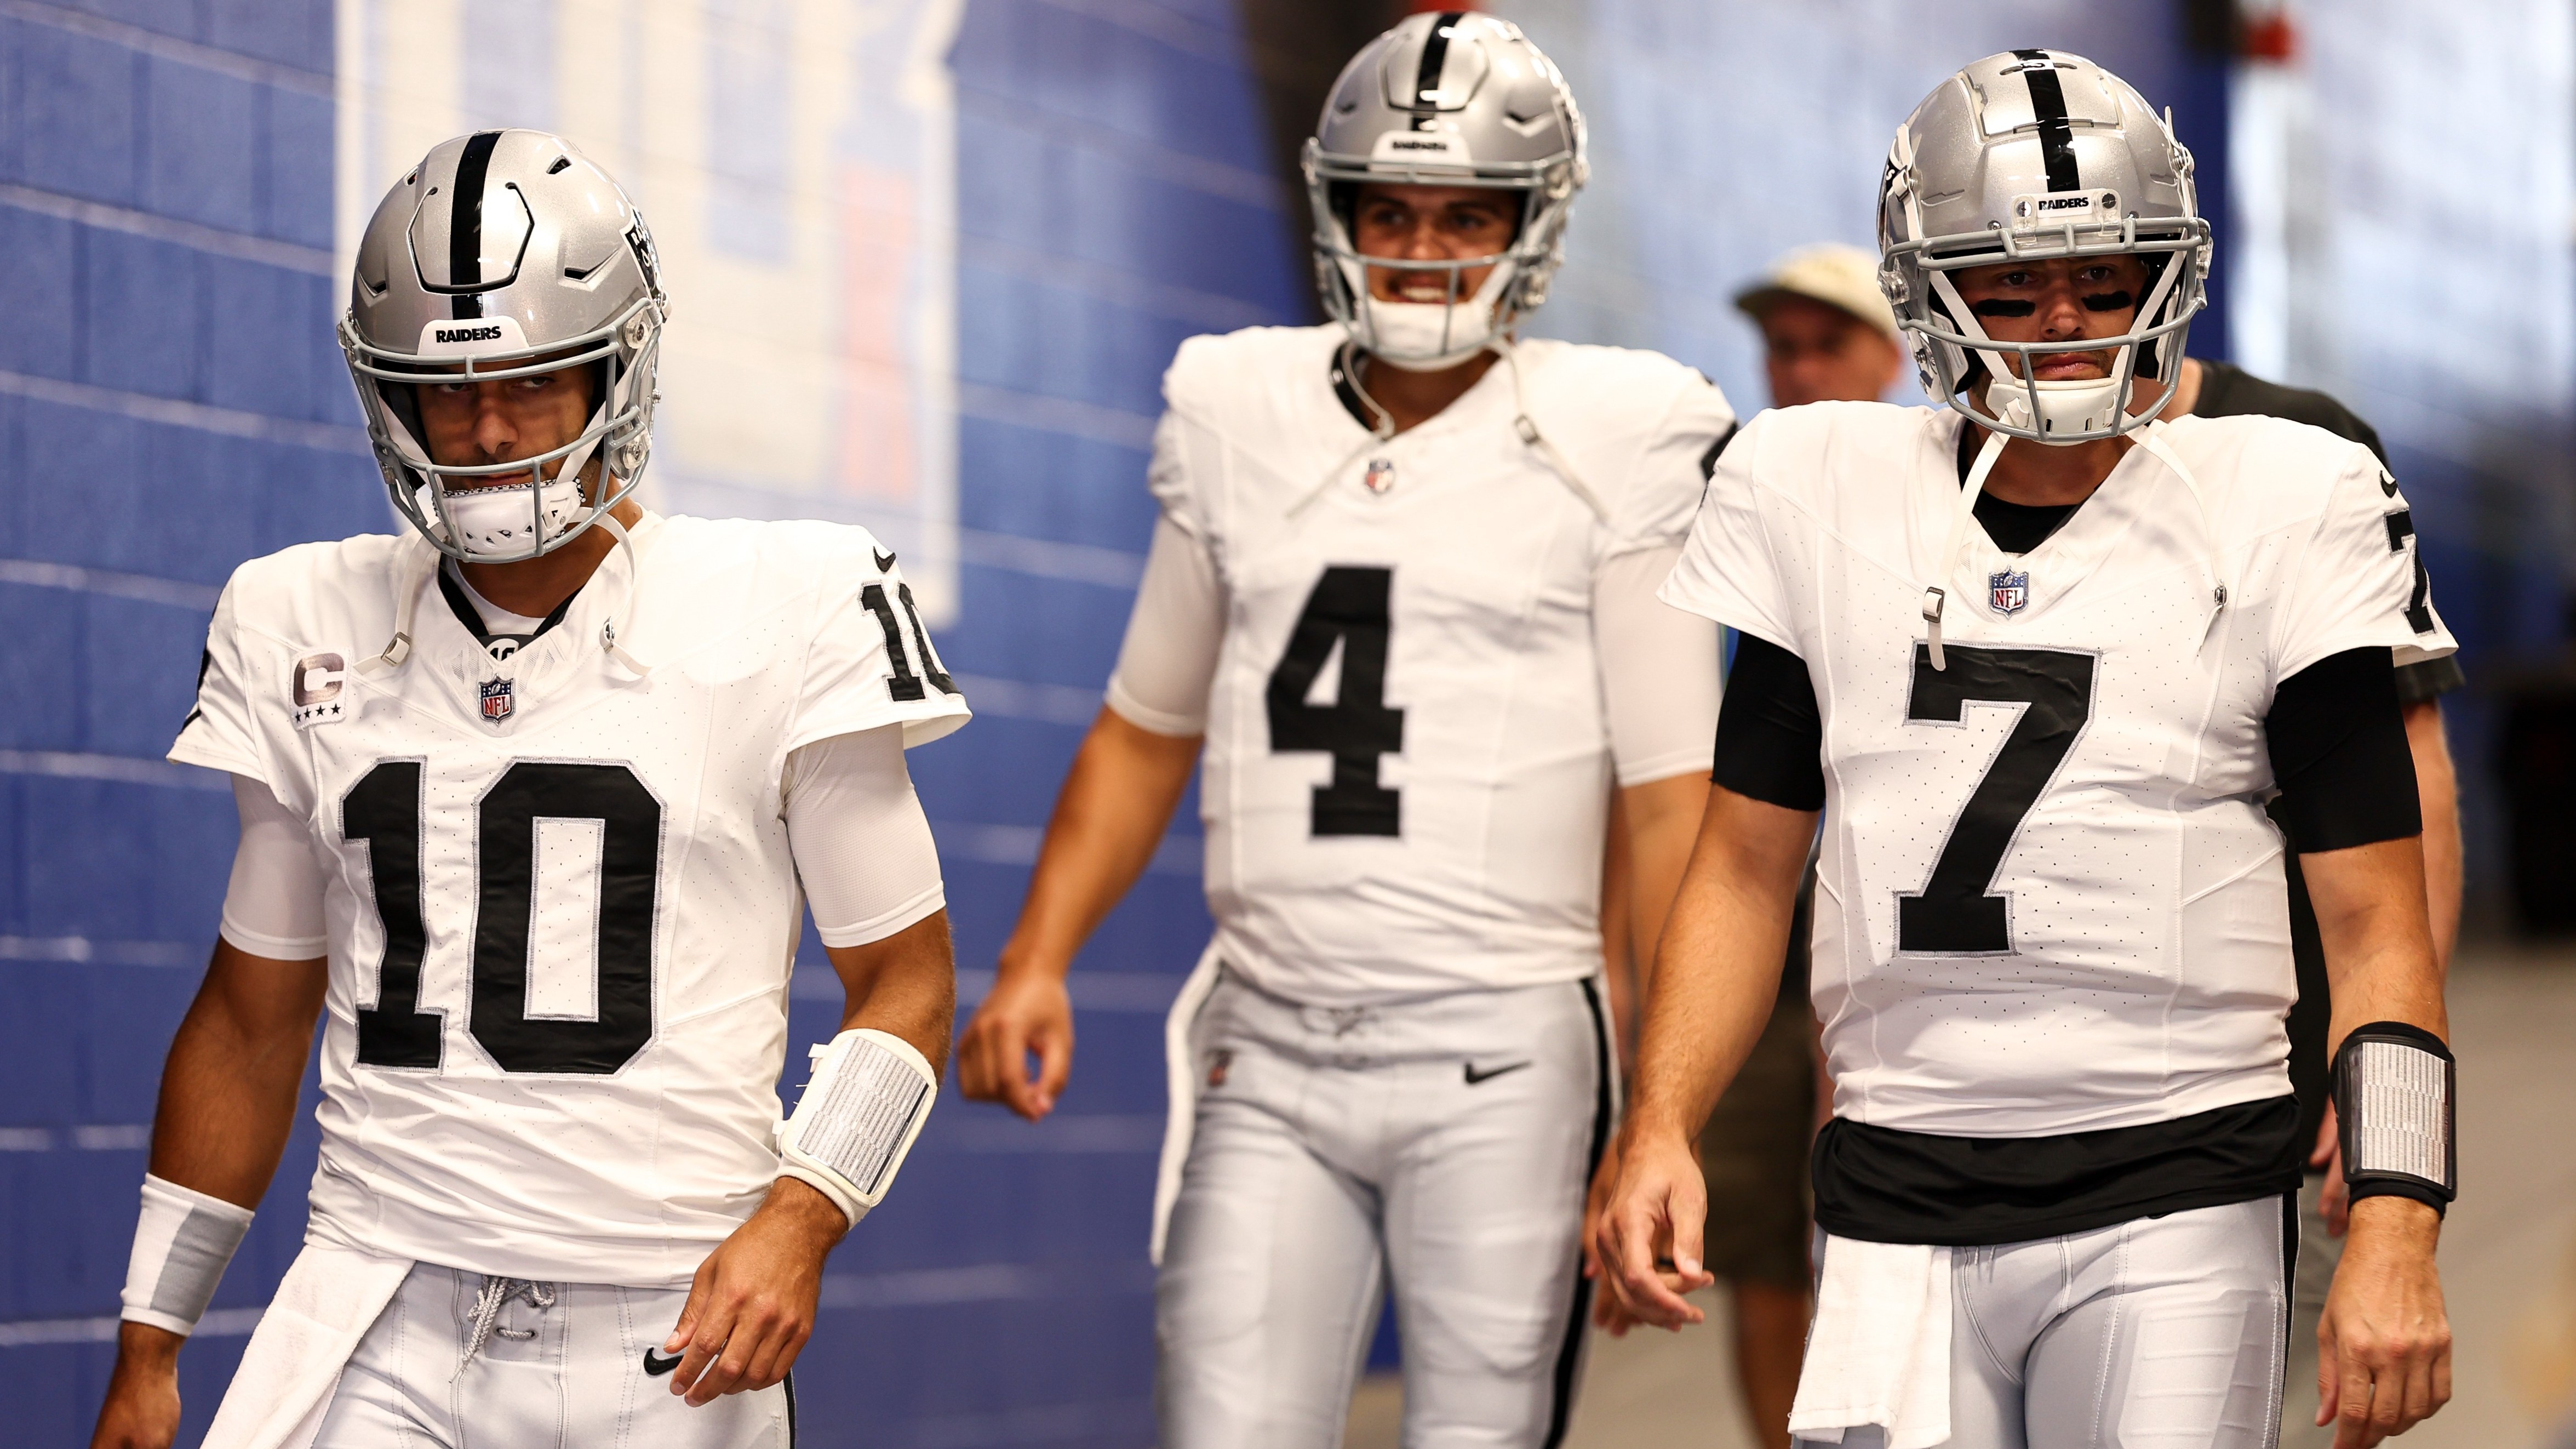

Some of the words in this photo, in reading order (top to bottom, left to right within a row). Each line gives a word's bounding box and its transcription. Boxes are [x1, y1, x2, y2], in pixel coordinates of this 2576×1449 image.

[2039, 197, 2089, 210] RAIDERS
[436, 326, 502, 343] RAIDERS
[1995, 590, 2022, 608] NFL
[293, 652, 345, 708] C
[483, 696, 510, 716] NFL
[1266, 566, 1404, 836] 4
[1893, 638, 2104, 958] 7
[338, 755, 667, 1080] 10
